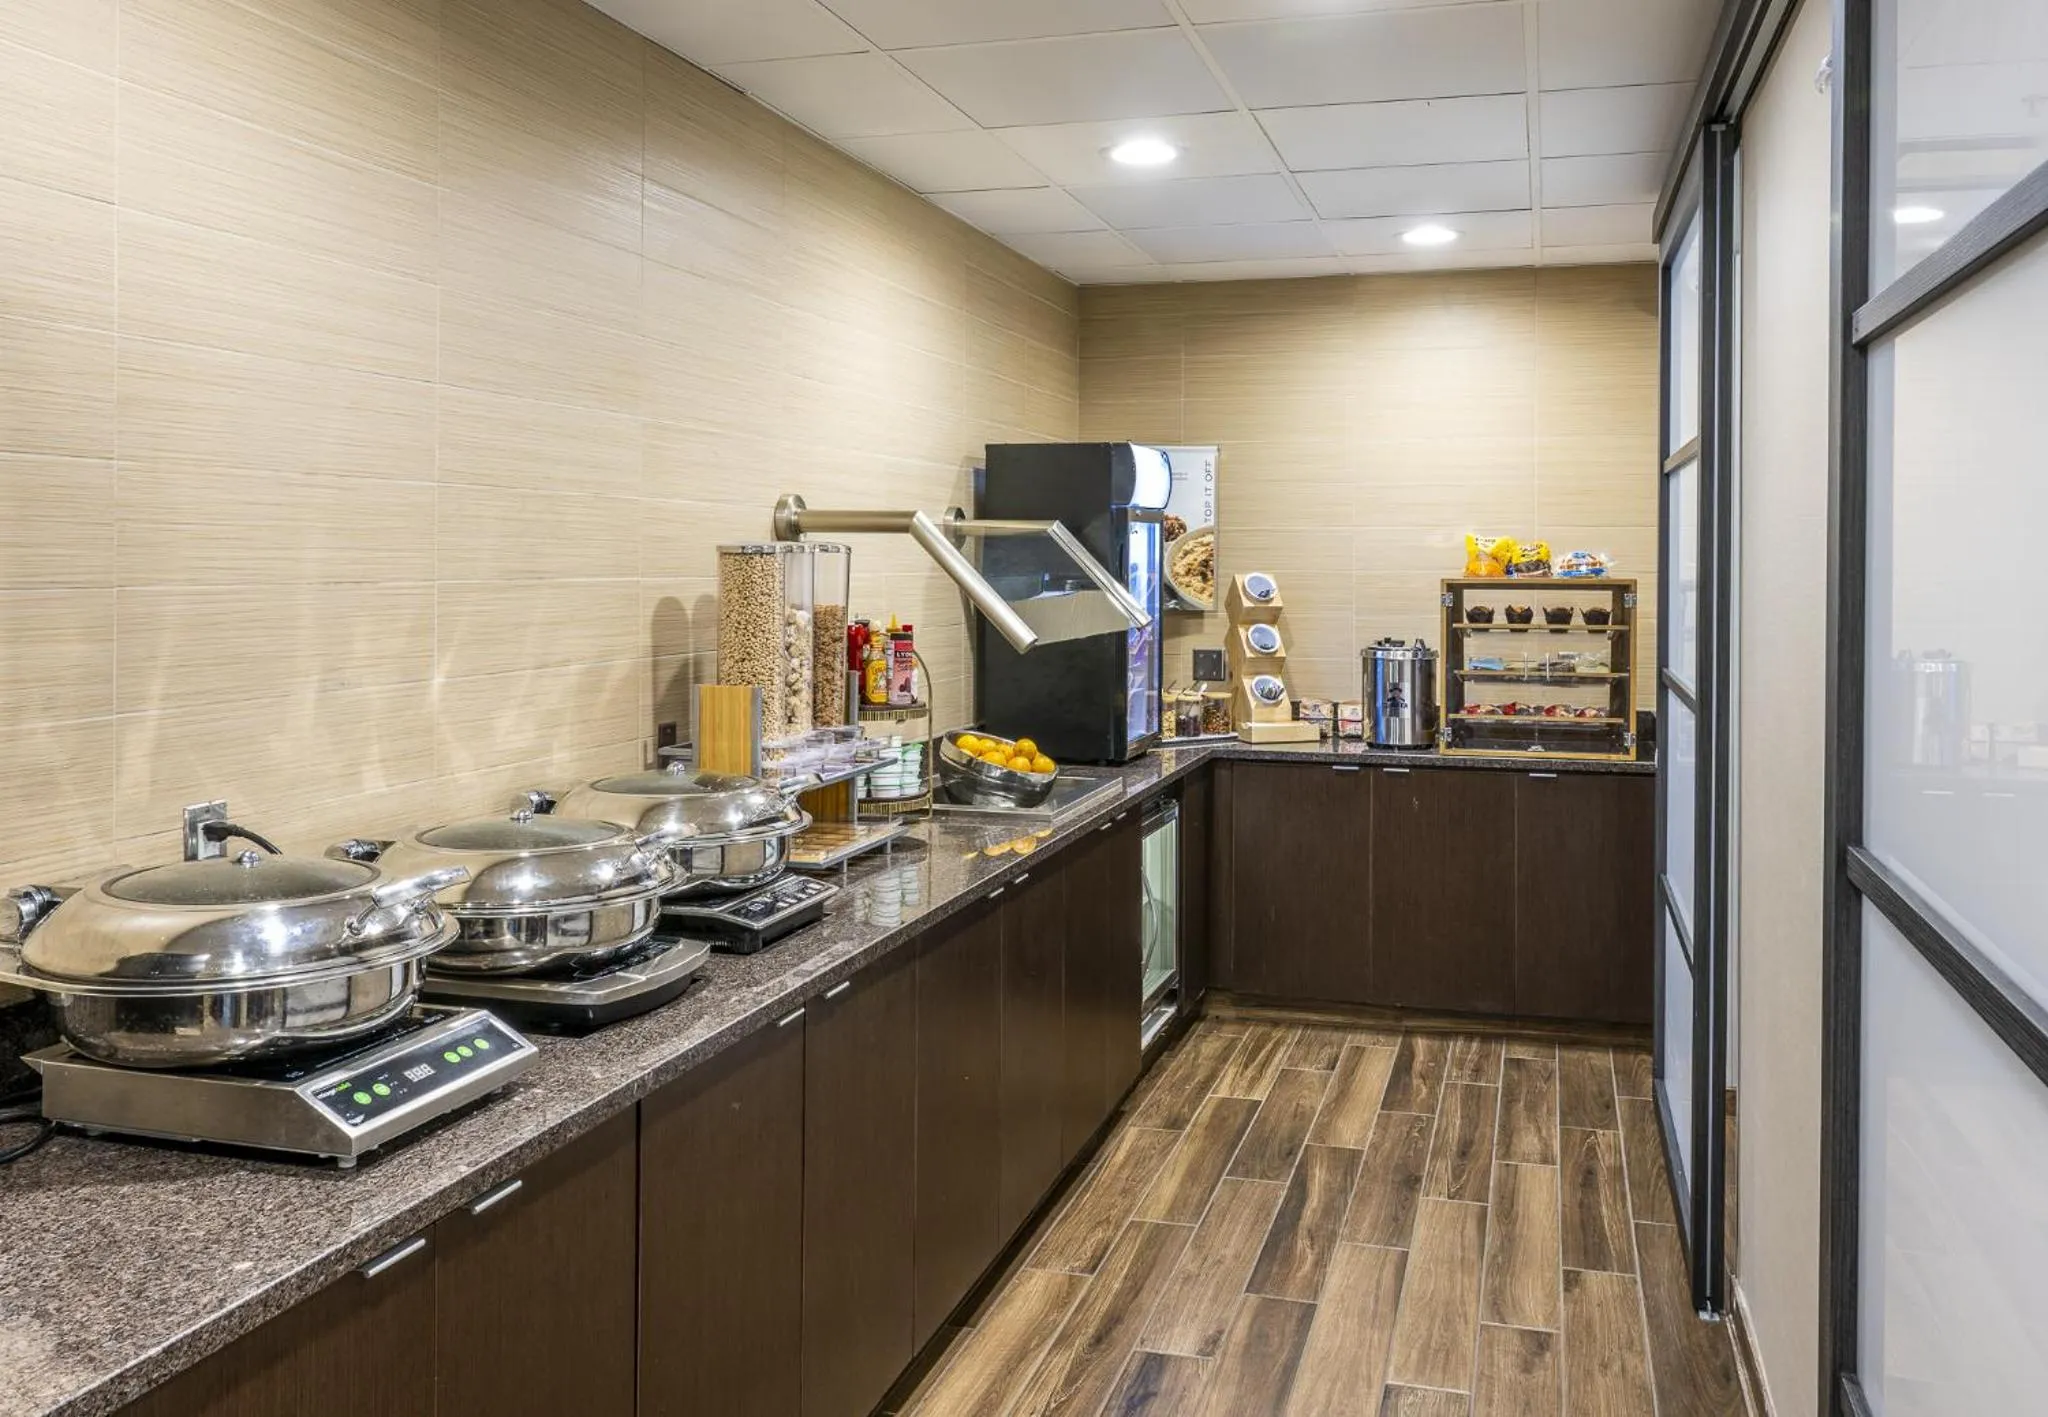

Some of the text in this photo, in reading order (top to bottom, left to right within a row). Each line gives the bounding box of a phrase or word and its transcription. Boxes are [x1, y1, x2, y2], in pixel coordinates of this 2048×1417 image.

[1204, 459, 1213, 523] TOP IT OFF
